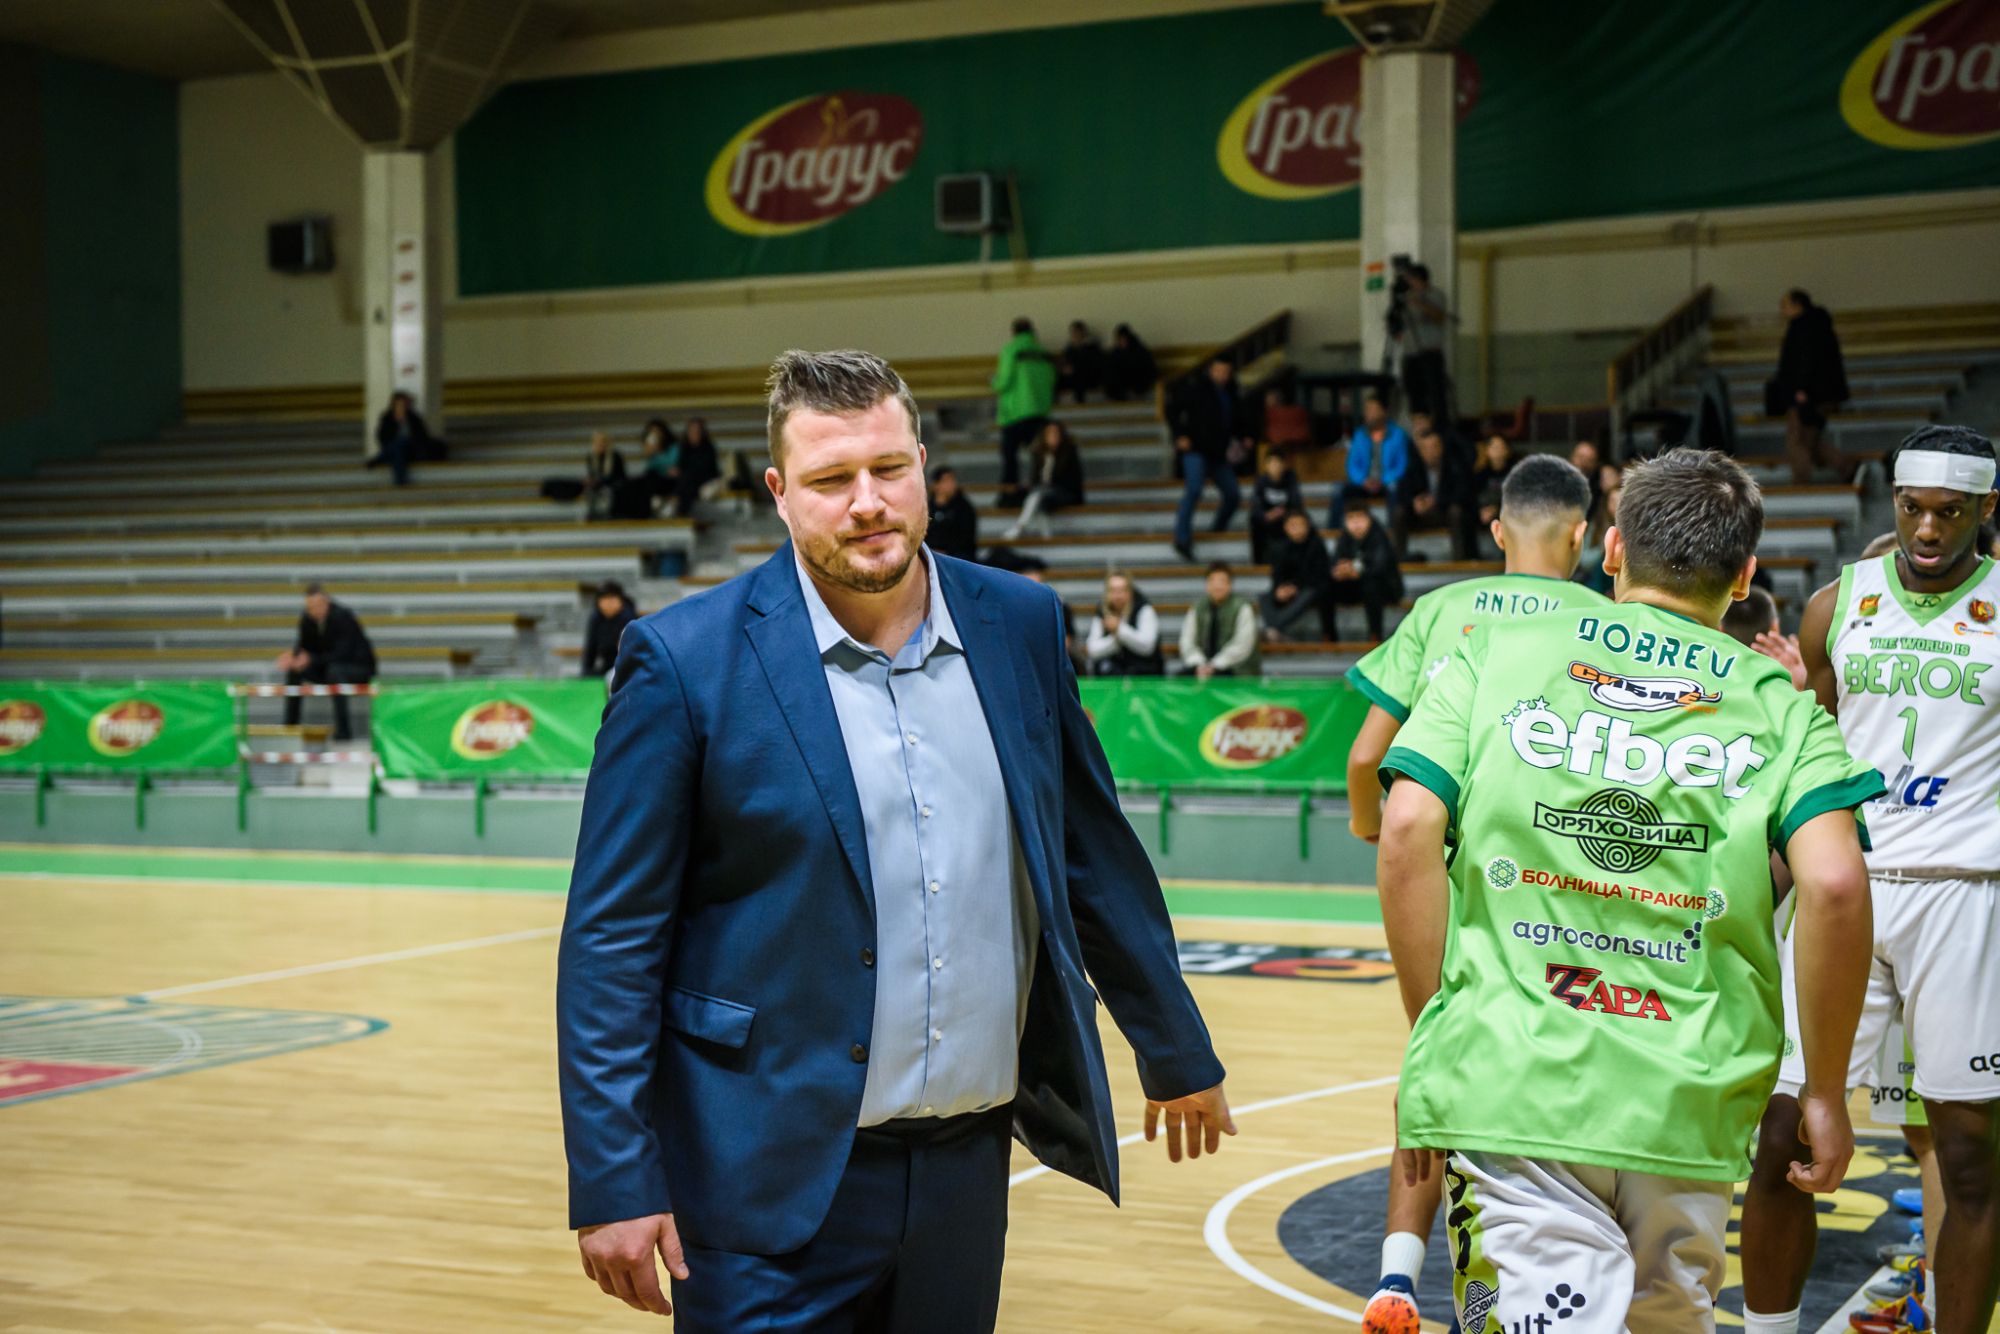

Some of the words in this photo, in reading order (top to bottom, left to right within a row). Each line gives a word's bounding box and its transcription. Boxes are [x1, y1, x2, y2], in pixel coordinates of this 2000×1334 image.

[1874, 33, 2000, 121] Гра
[1248, 95, 1363, 167] Гра
[731, 138, 913, 213] Градус
[1577, 617, 1738, 679] DOBREV
[1870, 637, 1899, 650] THE
[1900, 638, 1952, 654] WORLD
[1954, 643, 1970, 657] IS
[1844, 653, 1994, 706] BEROE
[1510, 709, 1767, 799] efbet
[1898, 706, 1918, 761] 1
[1870, 765, 1950, 807] ACE
[1544, 812, 1697, 846] ОРЯХОВИЦА
[1521, 869, 1623, 899] БОЛНИЦА
[1627, 886, 1707, 910] ТРАКИЯ
[1512, 920, 1688, 963] agroconsult
[1494, 1312, 1552, 1334] ult
